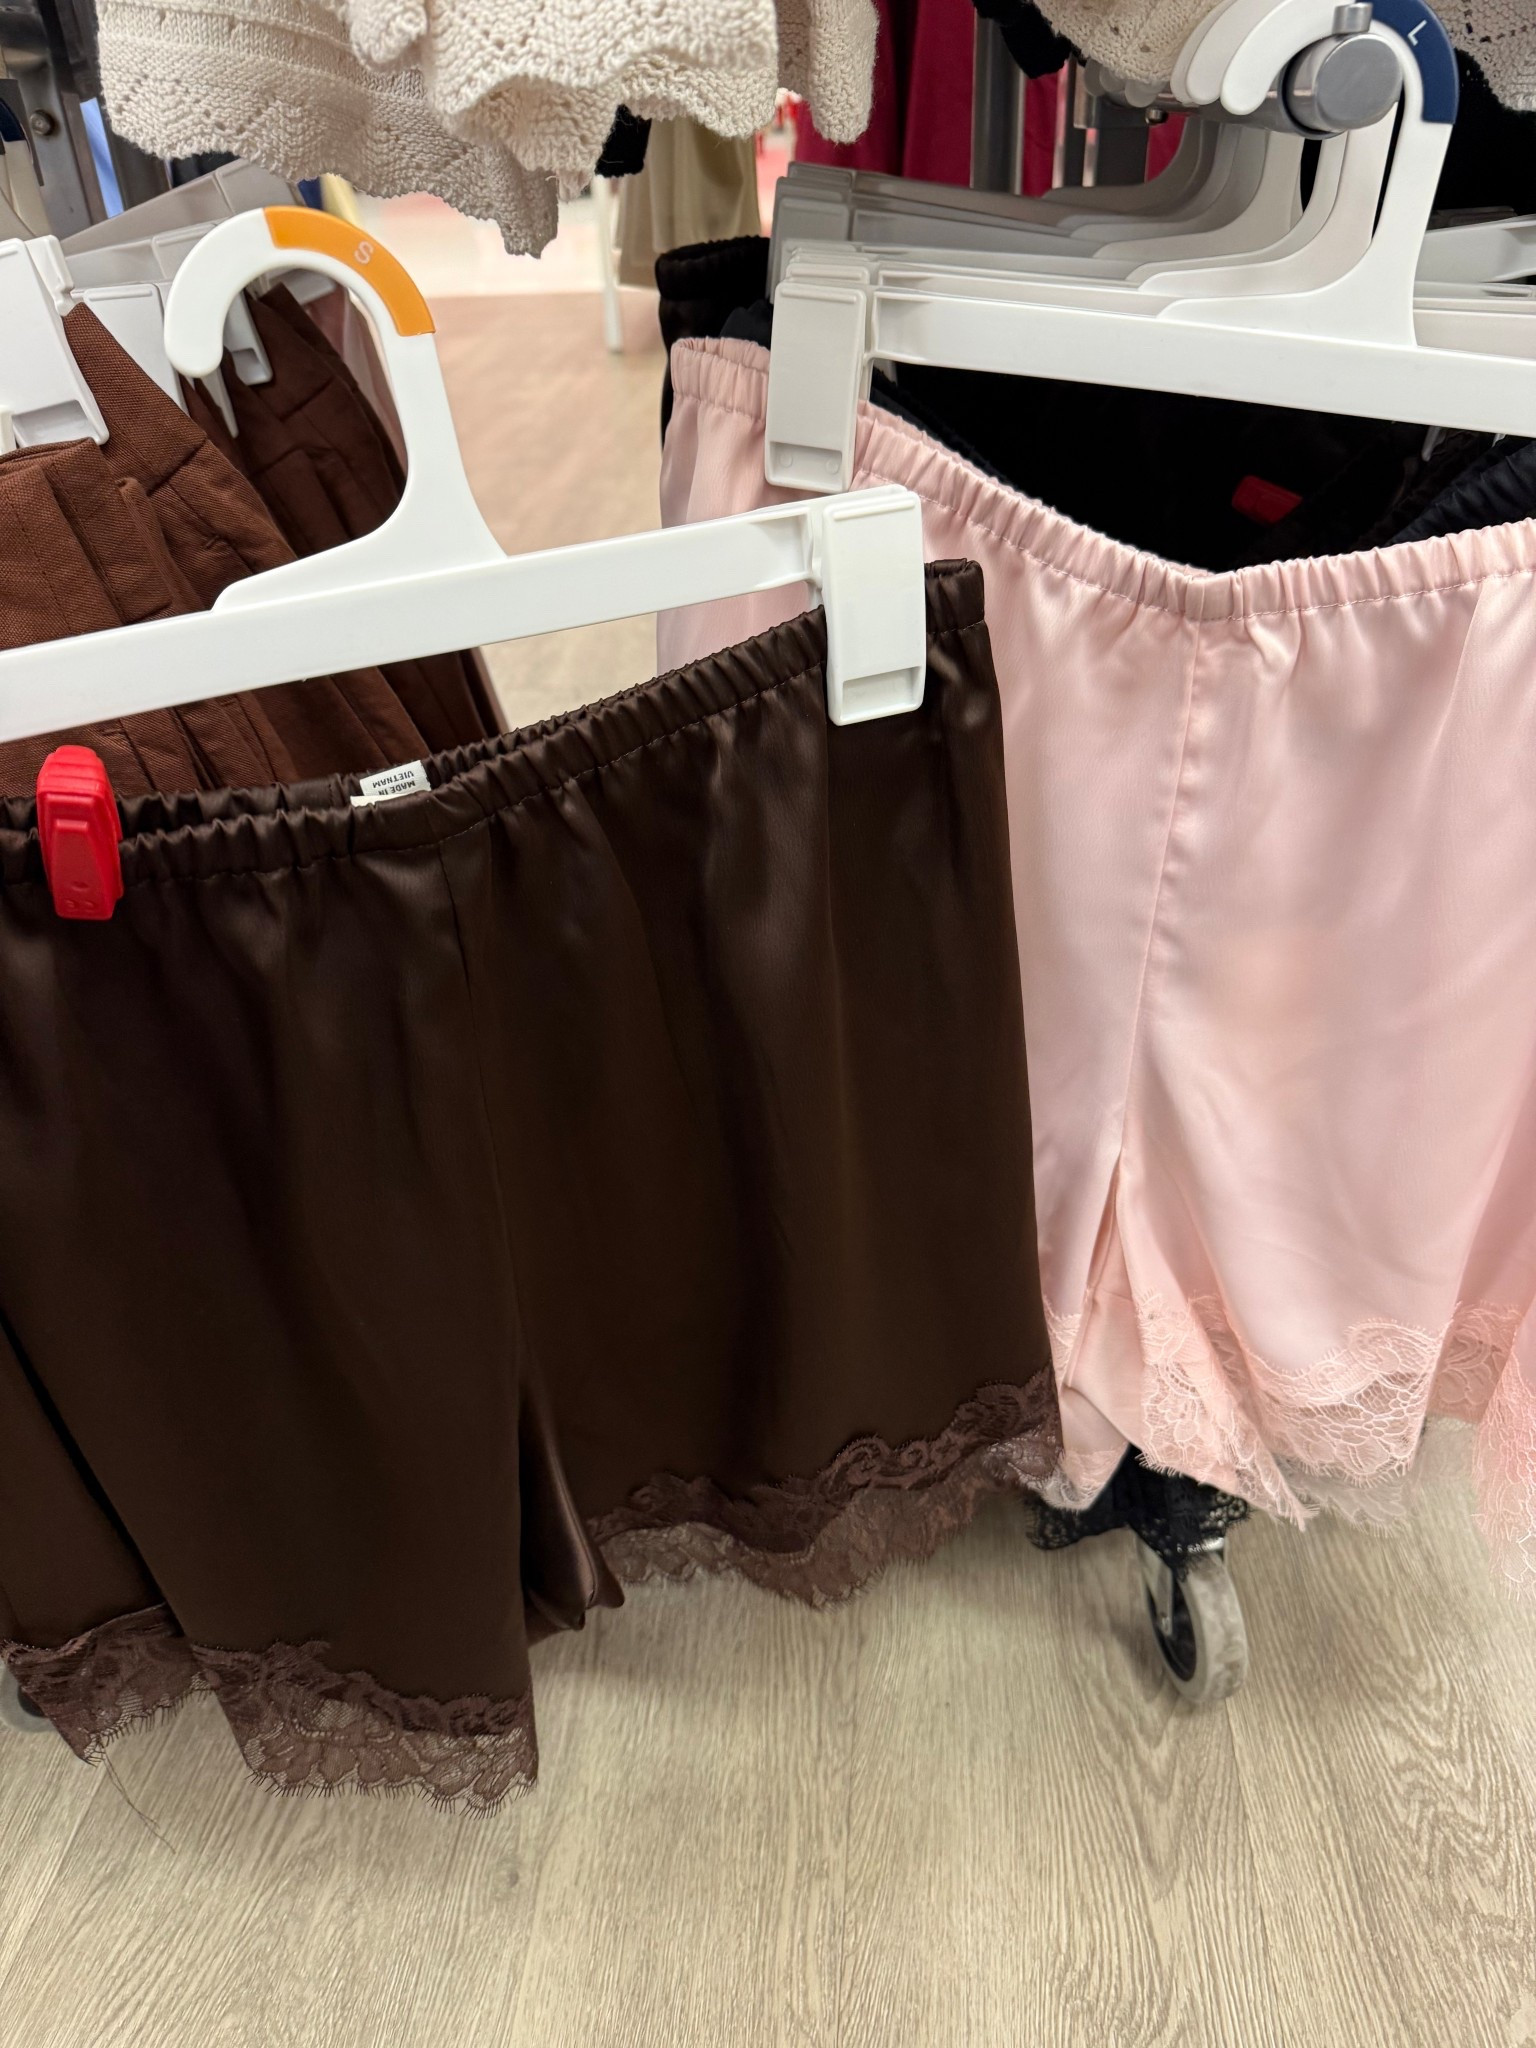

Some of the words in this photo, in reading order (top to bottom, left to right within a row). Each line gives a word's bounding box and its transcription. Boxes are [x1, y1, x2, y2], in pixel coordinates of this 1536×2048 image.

[1407, 19, 1427, 46] L
[354, 241, 374, 265] S
[372, 770, 414, 788] VIETNAM
[390, 780, 416, 794] MADE
[378, 788, 389, 796] IN
